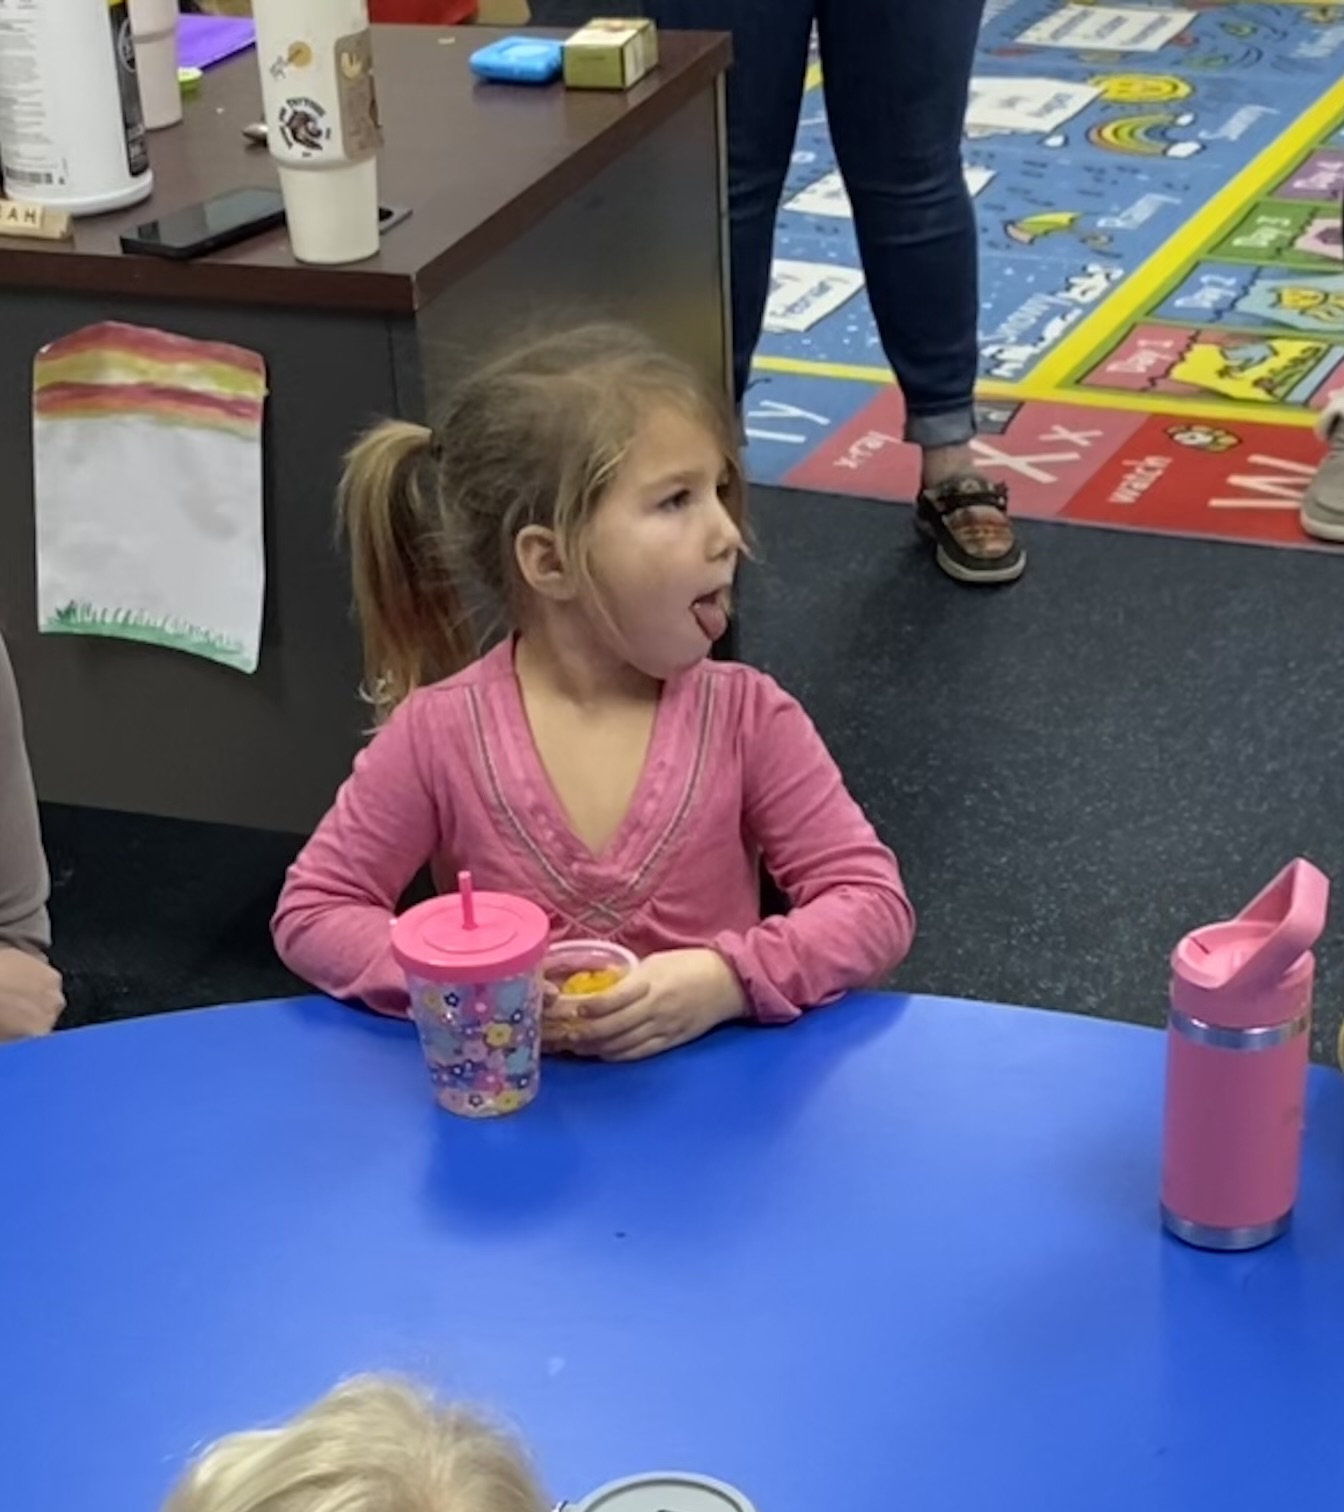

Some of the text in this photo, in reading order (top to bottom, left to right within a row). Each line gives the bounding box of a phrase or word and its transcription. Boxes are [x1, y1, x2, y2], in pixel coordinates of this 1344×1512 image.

[1174, 286, 1237, 308] Day
[1106, 349, 1175, 373] Day
[1108, 455, 1174, 505] watch
